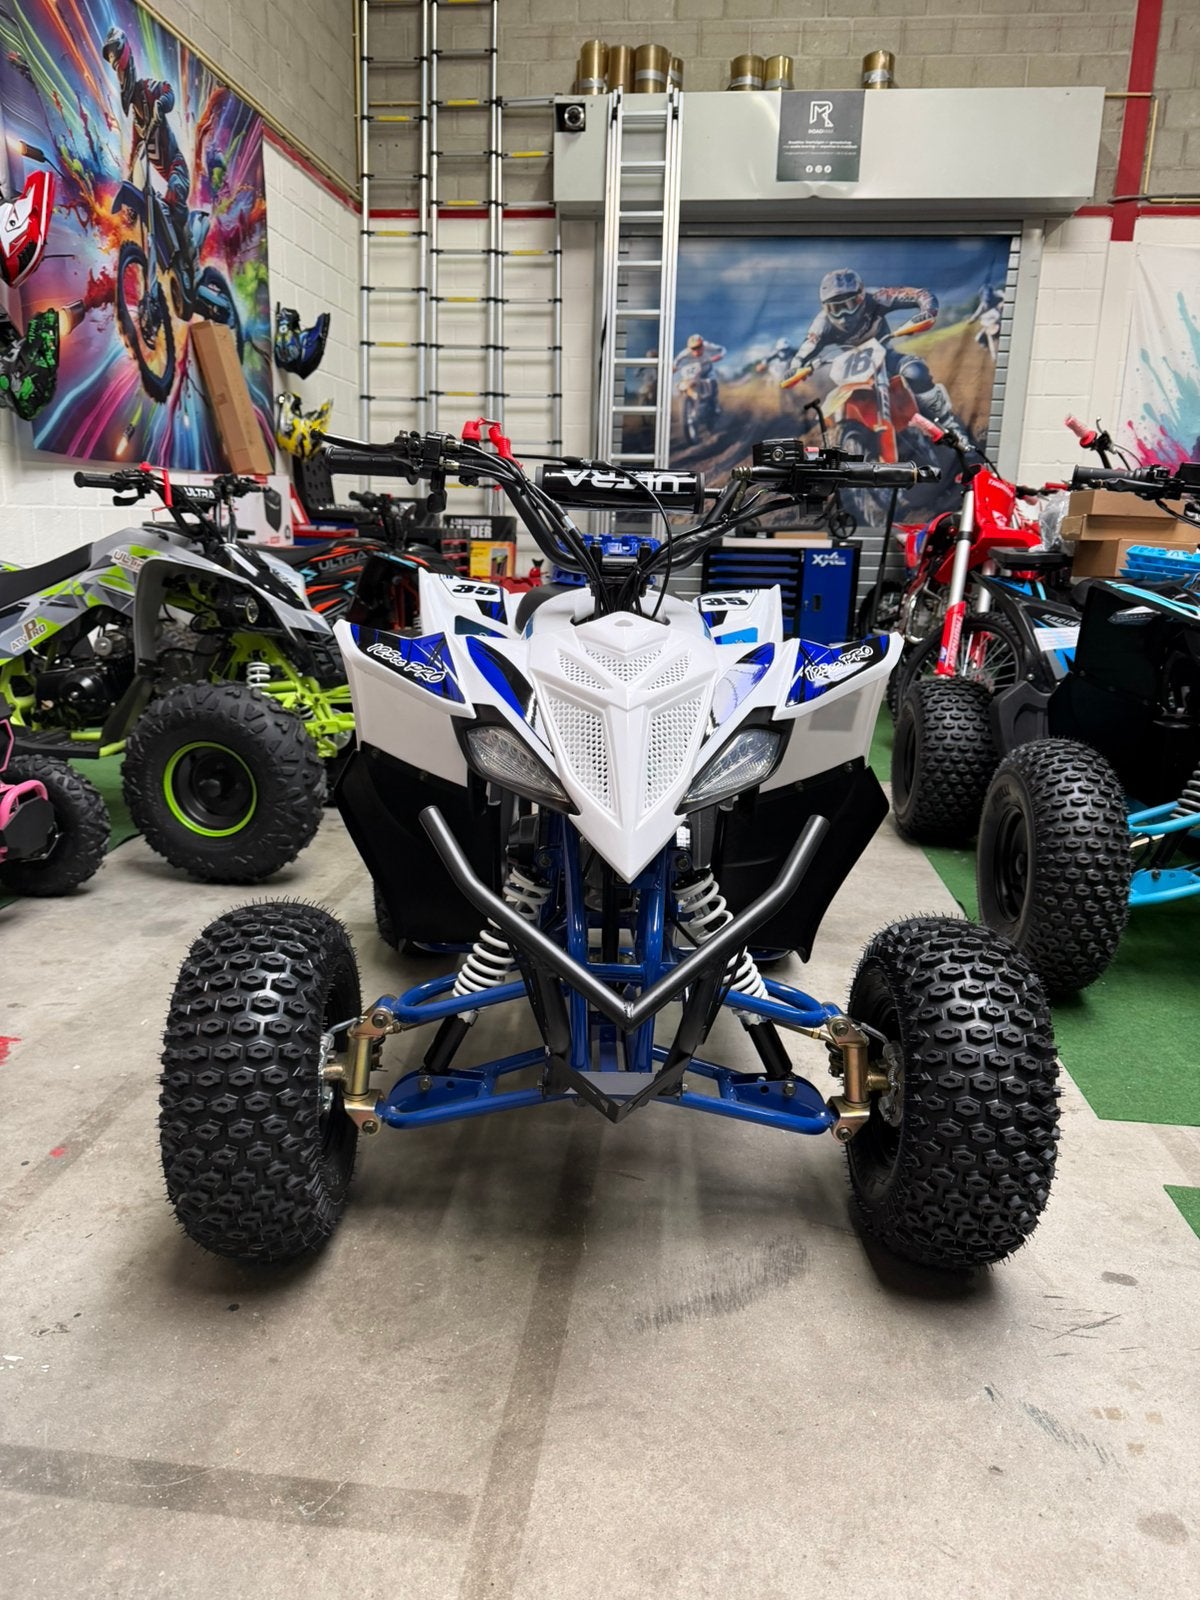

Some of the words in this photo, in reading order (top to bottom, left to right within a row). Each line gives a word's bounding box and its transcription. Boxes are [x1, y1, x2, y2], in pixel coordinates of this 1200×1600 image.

[183, 486, 215, 499] ULTRA
[319, 551, 368, 571] ULTRA
[452, 584, 499, 595] 35
[702, 597, 749, 606] 35
[838, 645, 874, 664] PRO
[367, 643, 408, 667] 125cc
[404, 661, 446, 683] PRO
